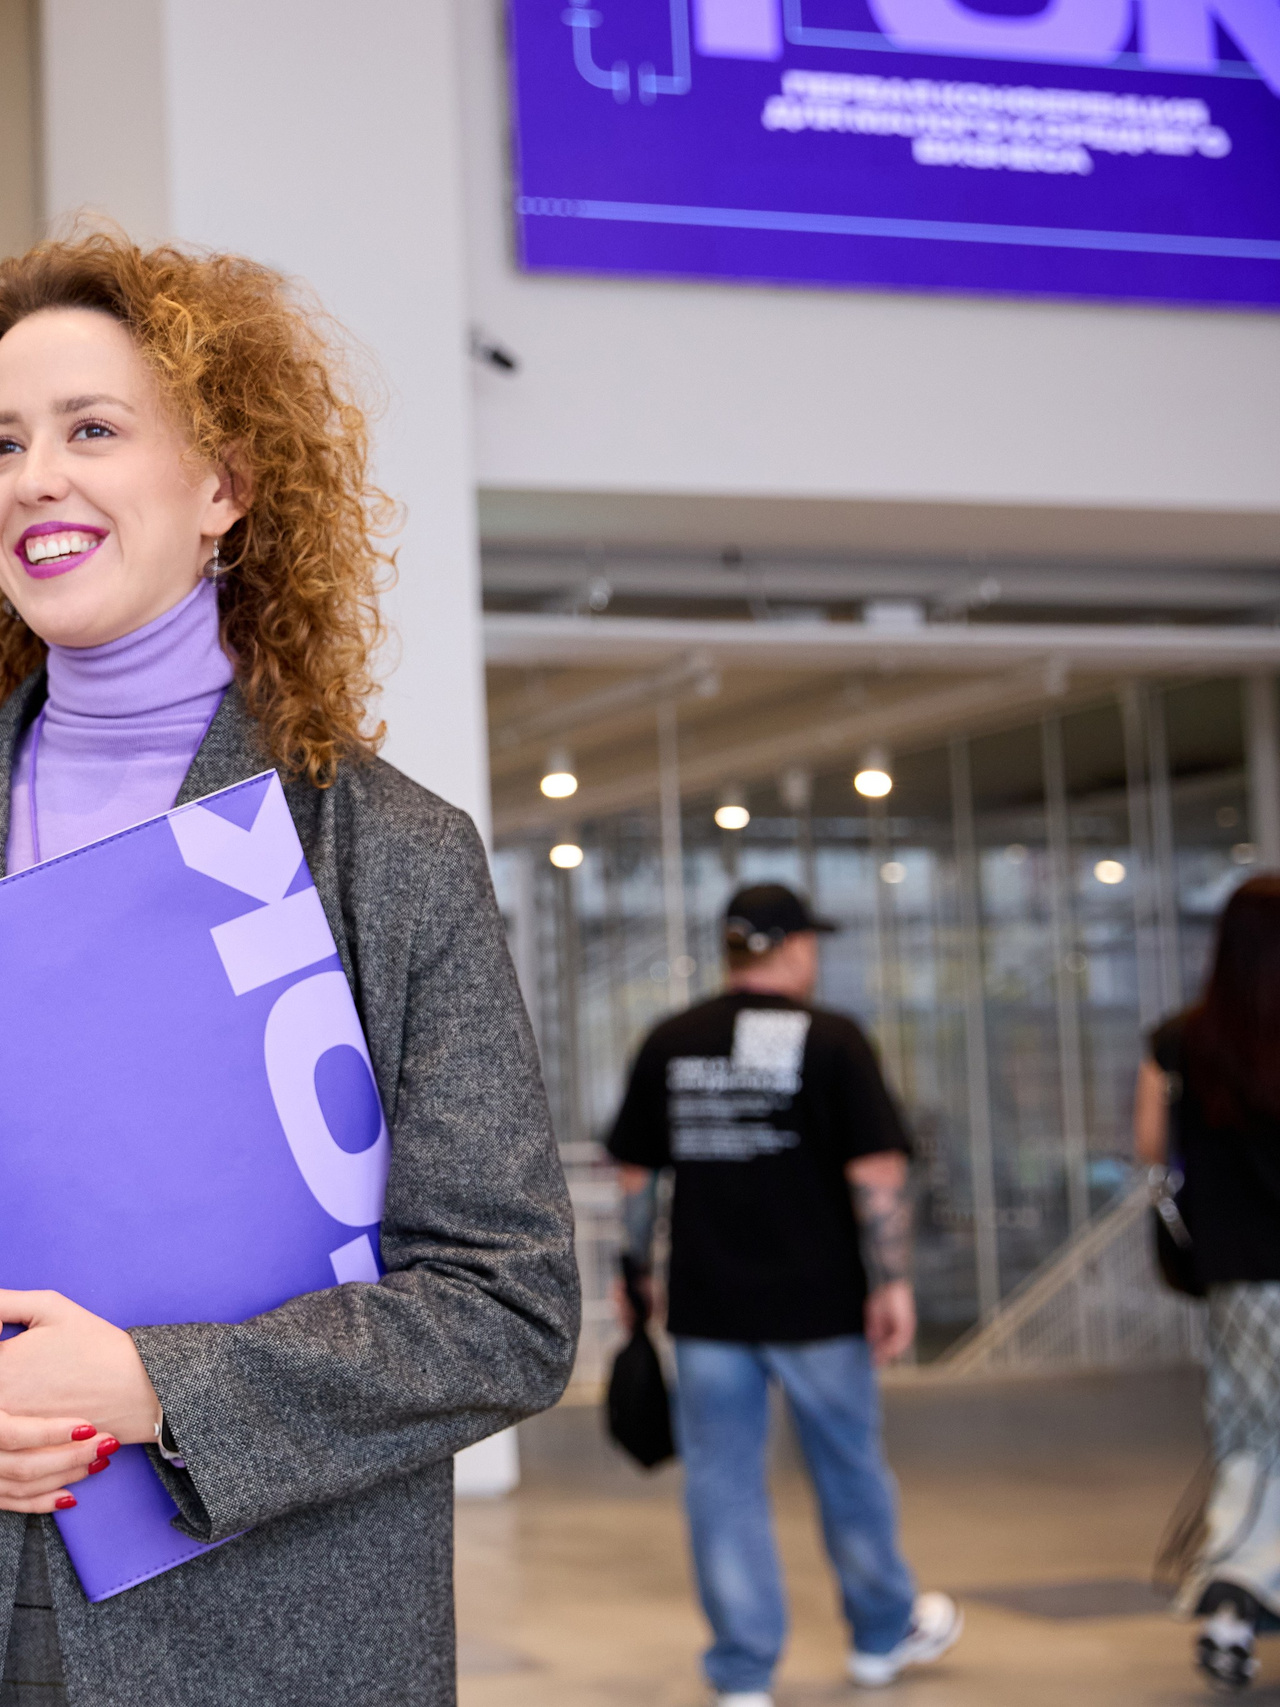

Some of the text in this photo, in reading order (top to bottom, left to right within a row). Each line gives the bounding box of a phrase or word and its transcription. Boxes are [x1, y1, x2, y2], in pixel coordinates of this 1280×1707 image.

[938, 84, 1208, 125] КОНФЕРЕНЦИЯ
[915, 136, 1089, 171] БИЗНЕСА
[167, 772, 392, 1285] ОК
